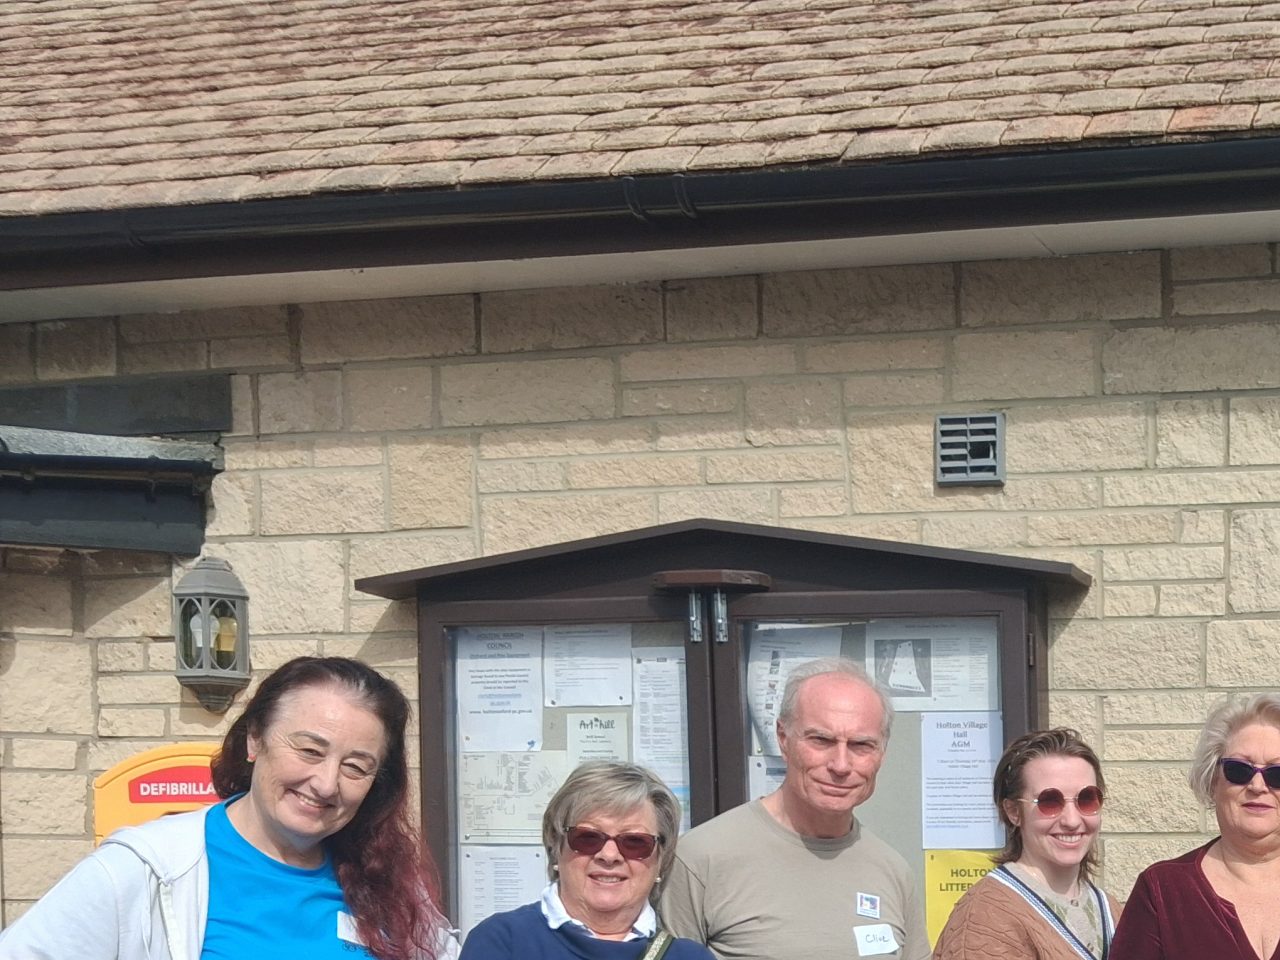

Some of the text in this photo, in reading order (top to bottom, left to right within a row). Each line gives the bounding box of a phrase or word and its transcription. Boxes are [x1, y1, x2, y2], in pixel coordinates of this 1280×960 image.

[963, 721, 988, 730] Village
[953, 731, 968, 739] Hall
[951, 740, 971, 748] AGM
[140, 782, 217, 796] DEFIBRILLA
